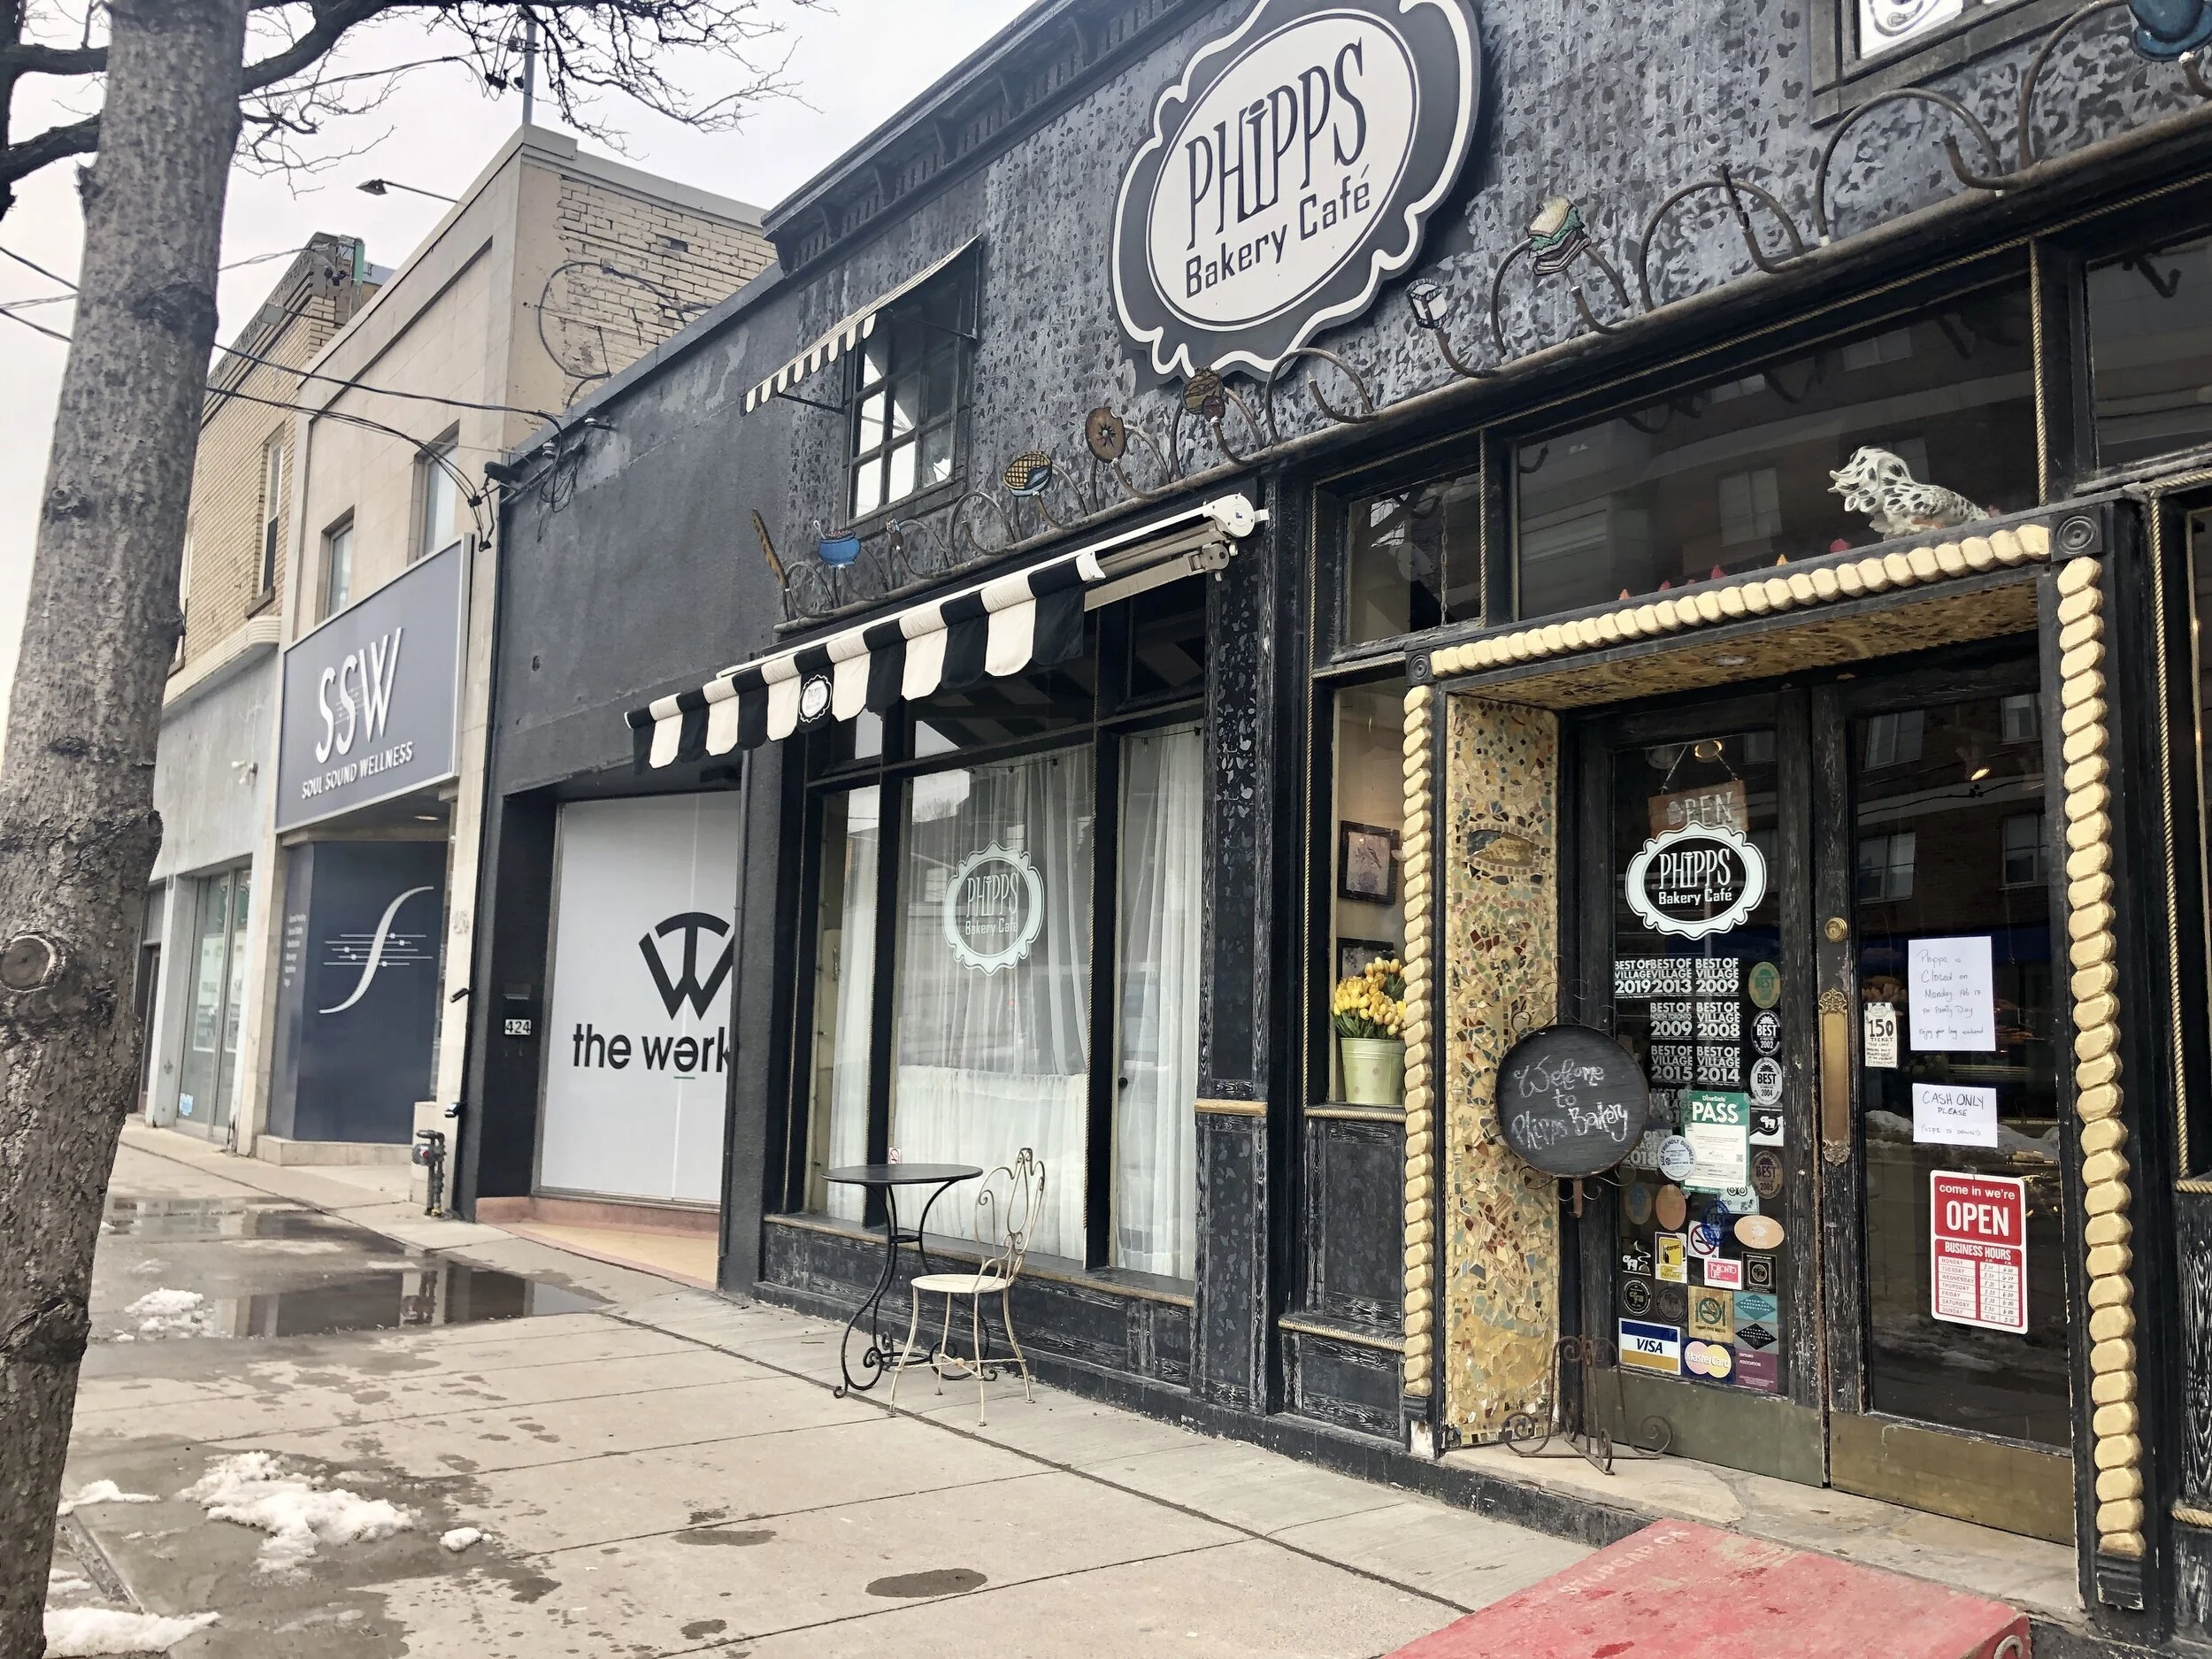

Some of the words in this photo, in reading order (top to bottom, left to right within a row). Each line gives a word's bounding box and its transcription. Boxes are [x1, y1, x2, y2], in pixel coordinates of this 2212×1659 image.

[1187, 224, 1287, 299] Bakery
[1300, 164, 1371, 241] Café
[316, 627, 403, 764] SSW
[303, 776, 322, 799] SOUL
[325, 763, 357, 790] SOUND
[359, 741, 413, 779] WELLNESS
[1659, 891, 1701, 905] Bakery
[1704, 887, 1732, 902] Café
[965, 920, 995, 936] Bakery
[1615, 960, 1636, 970] BEST
[1637, 959, 1651, 969] OF
[1650, 959, 1675, 969] BEST
[1676, 958, 1692, 969] OF
[1695, 958, 1722, 969] BEST
[1723, 957, 1739, 969] OF
[1916, 949, 1947, 968] Phipps
[1615, 970, 1651, 979] VILLAGE
[1651, 969, 1692, 979] VILLAGE
[1695, 969, 1739, 979] VILLAGE
[1921, 970, 1952, 983] Closed
[1615, 979, 1651, 994] 2019
[1651, 979, 1692, 993] 2013
[1695, 979, 1739, 993] 2009
[1925, 989, 1953, 1002] Monday
[1650, 1002, 1676, 1012] BEST
[1676, 1002, 1692, 1012] OF
[1696, 1002, 1723, 1012] BEST
[1724, 1002, 1740, 1013] OF
[1955, 1005, 1973, 1018] Day
[1696, 1013, 1740, 1023] VILLAGE
[505, 1020, 531, 1034] 424
[1650, 1021, 1693, 1036] 2009
[1697, 1023, 1740, 1037] 2008
[1756, 1024, 1778, 1036] BEST
[1869, 1019, 1893, 1037] 150
[573, 1024, 631, 1070] the
[1651, 1046, 1676, 1056] BEST
[1677, 1046, 1693, 1056] OF
[1696, 1046, 1723, 1056] BEST
[1724, 1047, 1740, 1057] OF
[1652, 1056, 1693, 1065] VILLAGE
[1697, 1057, 1740, 1068] VILLAGE
[1513, 1055, 1606, 1098] Welcome
[1651, 1065, 1693, 1080] 2015
[1697, 1067, 1740, 1082] 2014
[1757, 1073, 1777, 1085] BEST
[1552, 1089, 1578, 1108] to
[1922, 1091, 1953, 1105] CASH
[1956, 1094, 1984, 1110] ONLY
[1692, 1102, 1739, 1124] PASS
[1938, 1107, 1968, 1116] PLEASE
[1511, 1110, 1568, 1150] Phipps
[1568, 1102, 1628, 1142] Bakery
[1755, 1165, 1776, 1179] BEST
[1939, 1185, 1968, 1194] come
[1971, 1186, 1981, 1196] in
[1985, 1189, 2015, 1200] we're
[1947, 1200, 2008, 1237] OPEN
[1945, 1241, 1983, 1257] BUSINESS
[1985, 1247, 2011, 1261] HOURS
[1709, 1263, 1736, 1274] TORONTO
[1637, 1338, 1663, 1354] VISA
[1686, 1352, 1731, 1368] MasterCard
